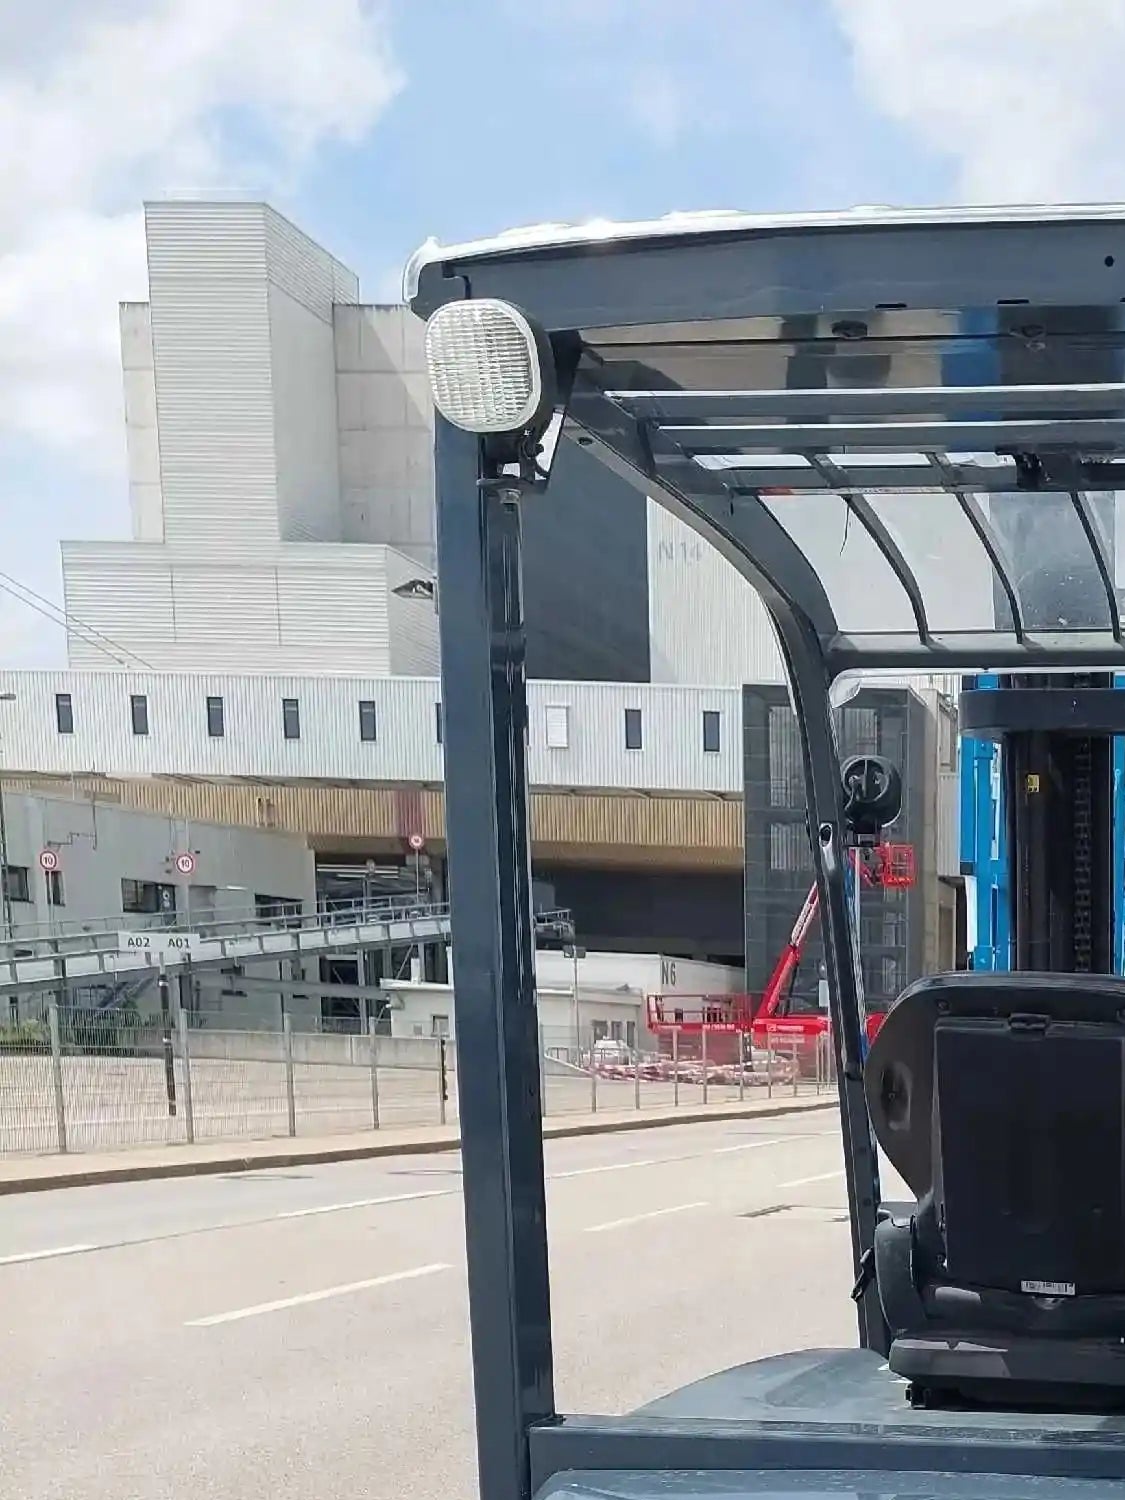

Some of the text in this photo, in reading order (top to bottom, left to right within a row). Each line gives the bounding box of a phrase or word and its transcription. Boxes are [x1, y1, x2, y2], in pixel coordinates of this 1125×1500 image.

[127, 937, 151, 948] A02
[167, 938, 190, 948] A01
[661, 961, 677, 986] N6
